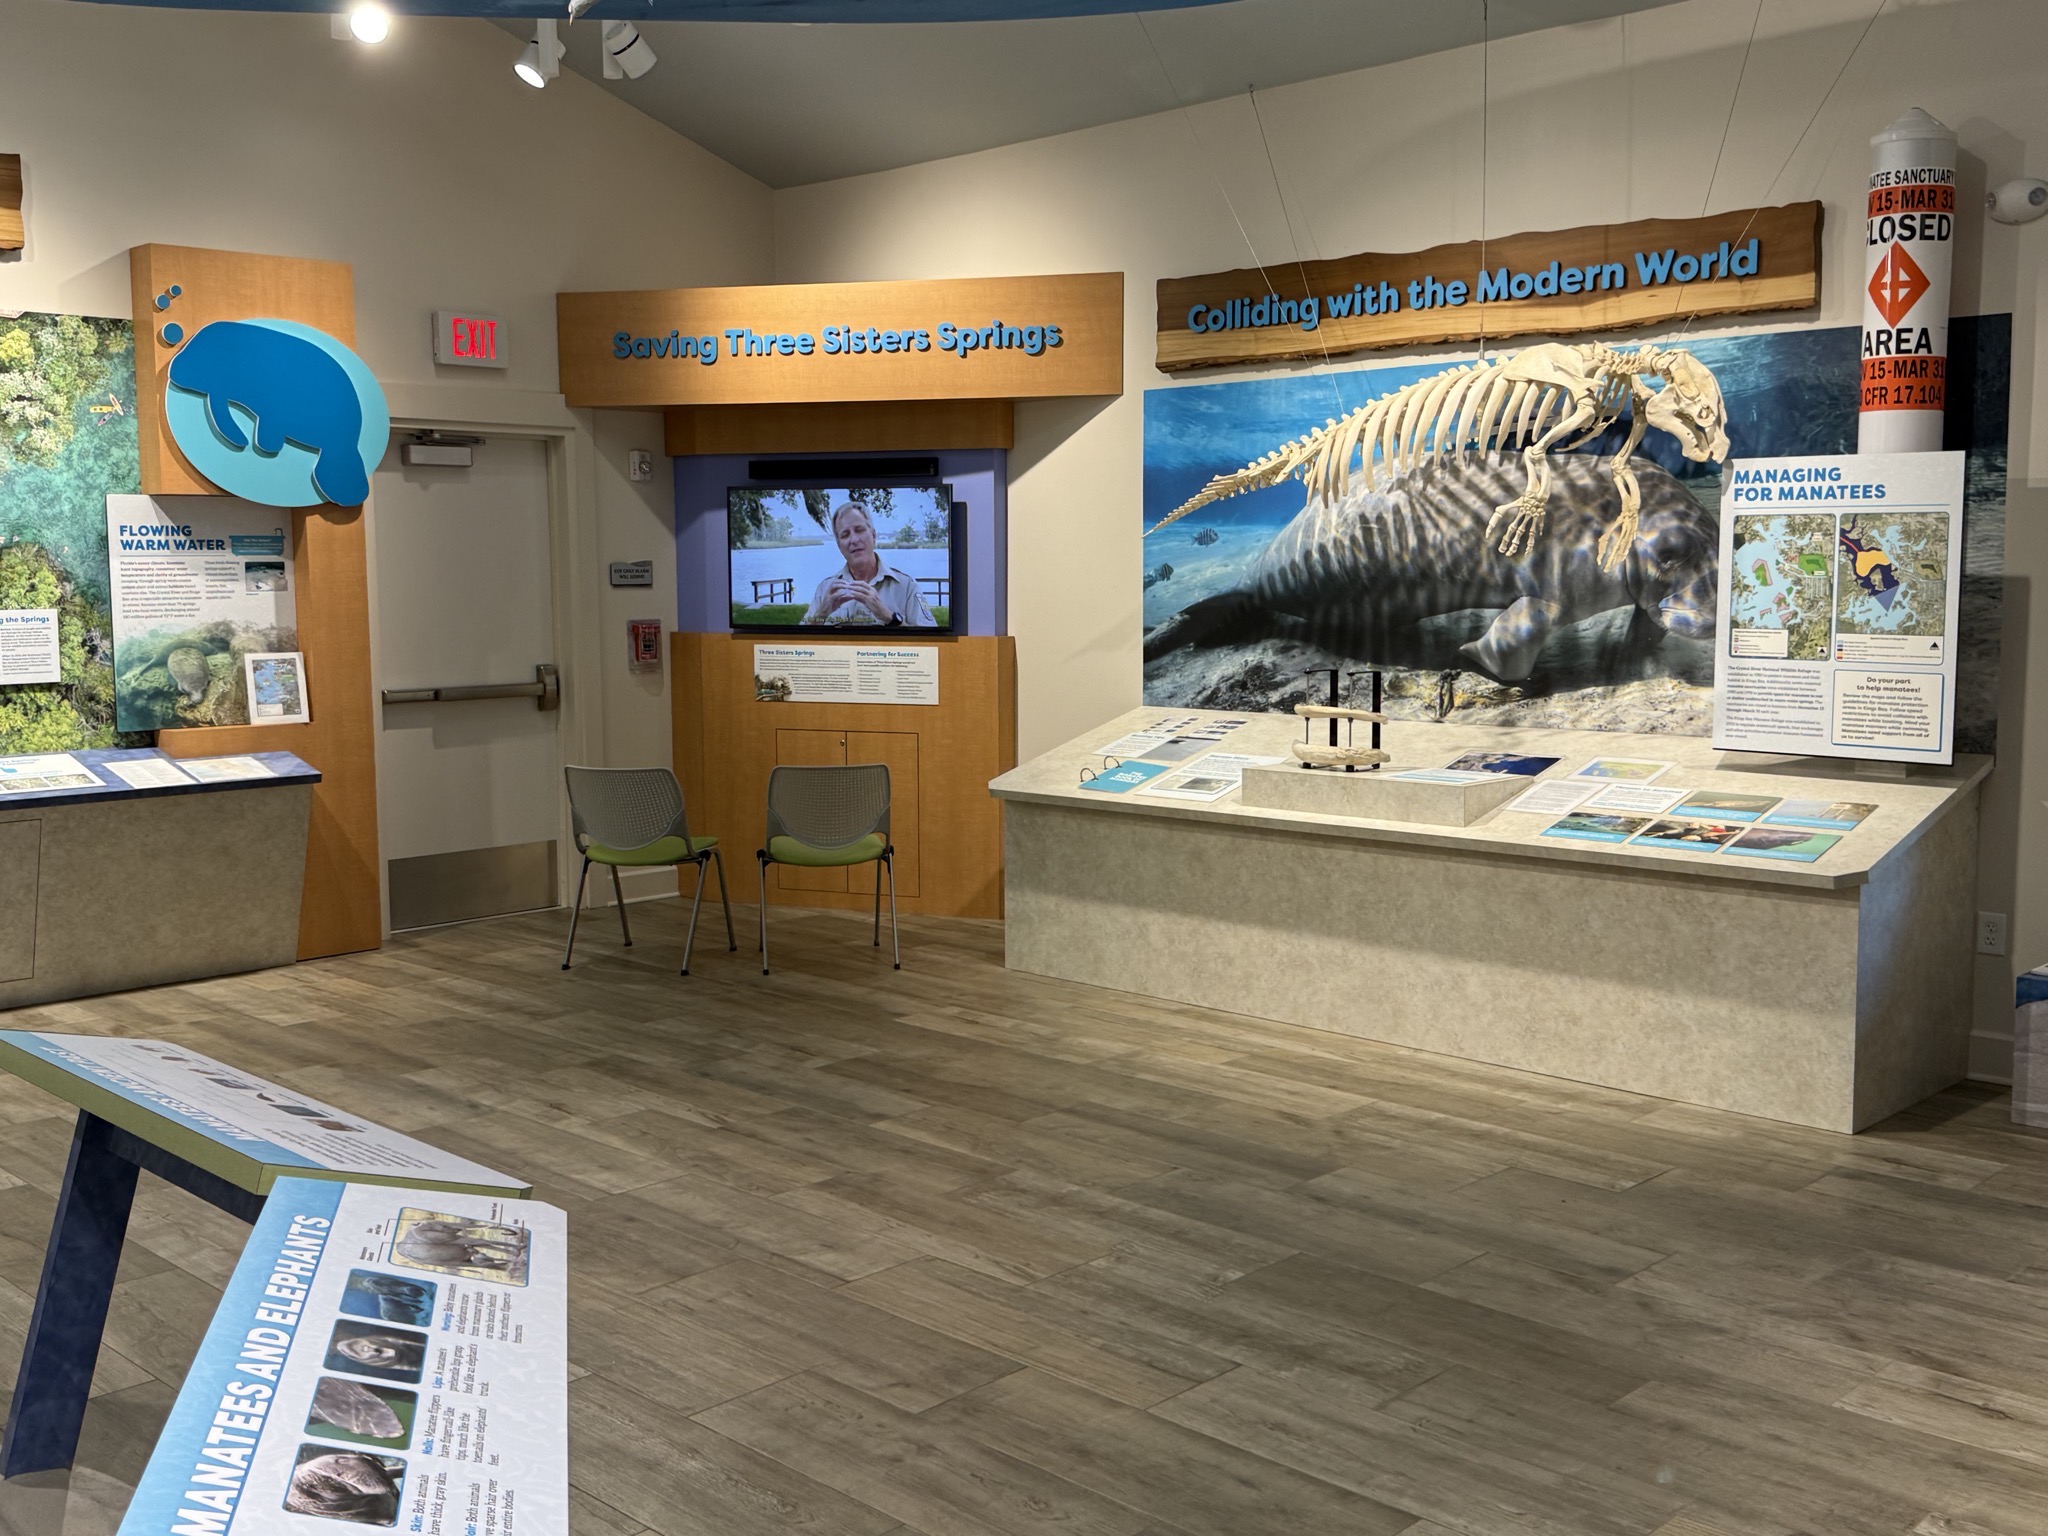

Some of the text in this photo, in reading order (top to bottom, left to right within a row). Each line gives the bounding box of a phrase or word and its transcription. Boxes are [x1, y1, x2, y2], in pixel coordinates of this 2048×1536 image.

[1941, 189, 1954, 209] 31
[1187, 238, 1759, 333] Colliding with the Modern World
[452, 318, 497, 359] EXIT
[613, 320, 1062, 364] Saving Three Sisters Springs
[1863, 328, 1932, 358] AREA
[1933, 360, 1944, 379] 31
[1865, 386, 1888, 406] CFR
[1734, 467, 1842, 484] MANAGING
[1734, 484, 1886, 501] FOR MANATEES
[120, 525, 192, 537] FLOWING
[120, 539, 170, 551] WARM
[173, 539, 226, 551] WATER
[21, 615, 50, 624] Springs
[170, 1214, 331, 1536] MANATEES AND ELEPHANTS
[489, 1479, 498, 1493] over
[410, 1474, 429, 1532] Skin: Both animals
[464, 1483, 481, 1536] air: Both animals
[485, 1493, 498, 1506] hair
[428, 1519, 442, 1536] have
[435, 1486, 448, 1501] gray
[486, 1506, 498, 1527] sparse
[502, 1510, 514, 1530] entire
